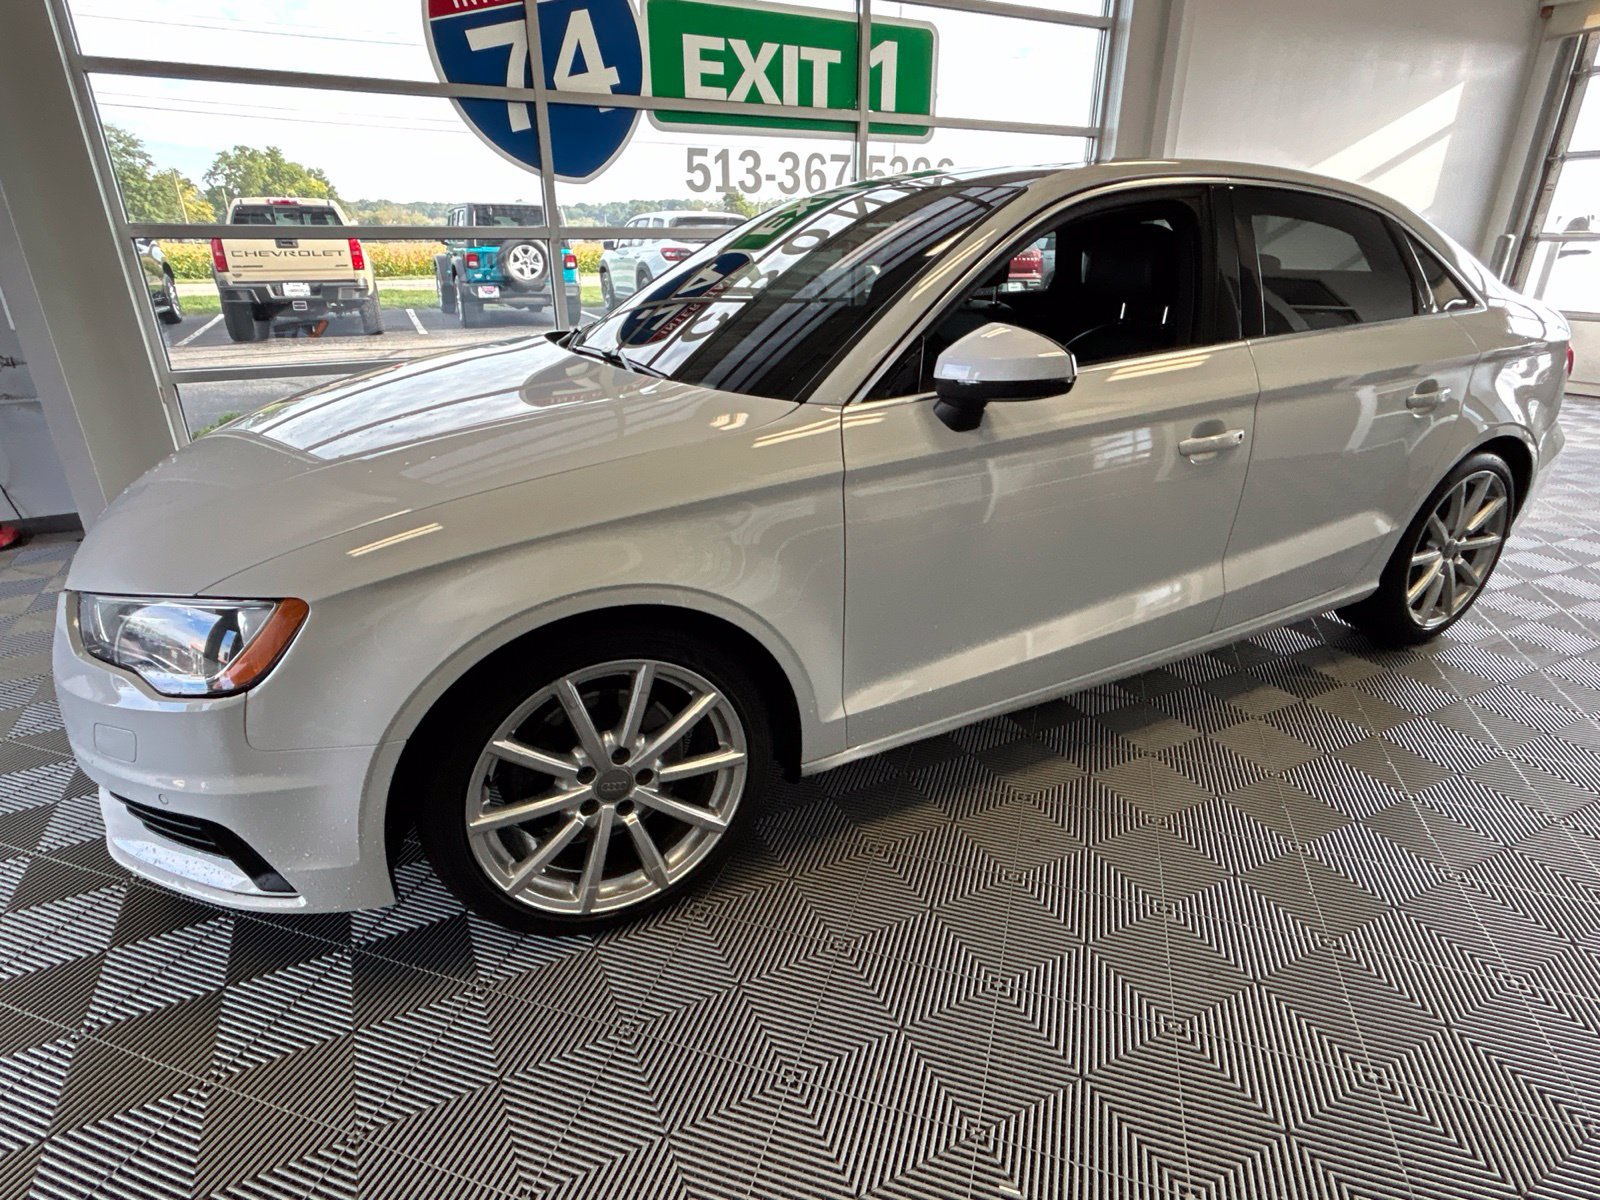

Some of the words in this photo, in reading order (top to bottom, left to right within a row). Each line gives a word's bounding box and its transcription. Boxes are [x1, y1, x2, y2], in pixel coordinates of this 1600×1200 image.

[465, 8, 621, 133] 74
[682, 33, 842, 109] EXIT
[869, 40, 898, 112] 1
[231, 250, 345, 258] CHEVROLET
